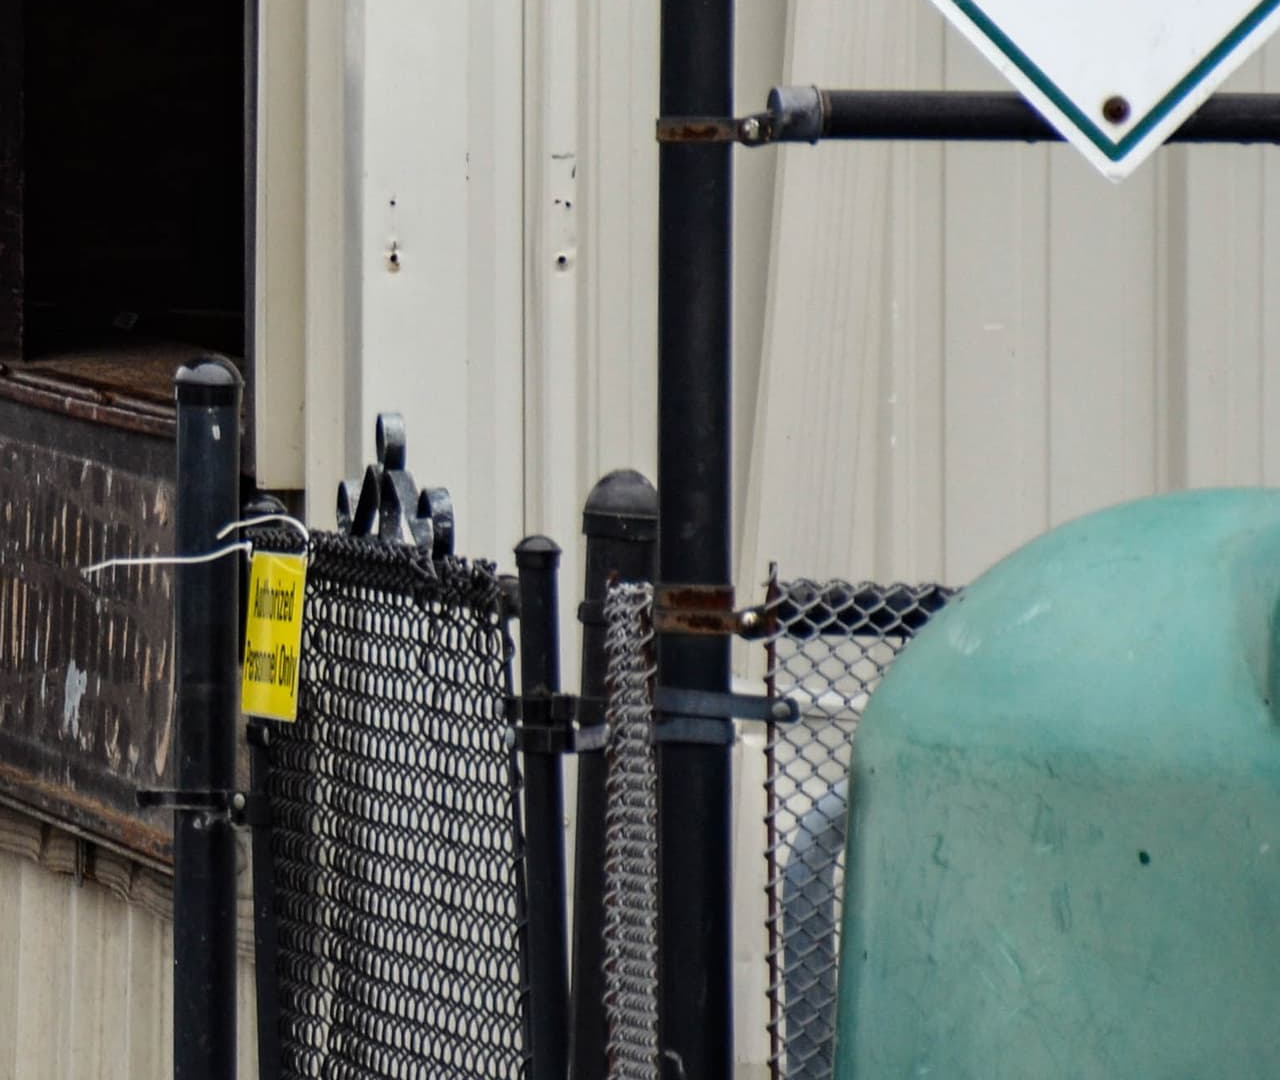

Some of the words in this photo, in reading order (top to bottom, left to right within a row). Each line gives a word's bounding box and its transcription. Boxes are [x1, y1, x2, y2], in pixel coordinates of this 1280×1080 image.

[253, 576, 296, 623] Authorized
[244, 640, 278, 686] Personnel
[278, 642, 298, 697] Only
